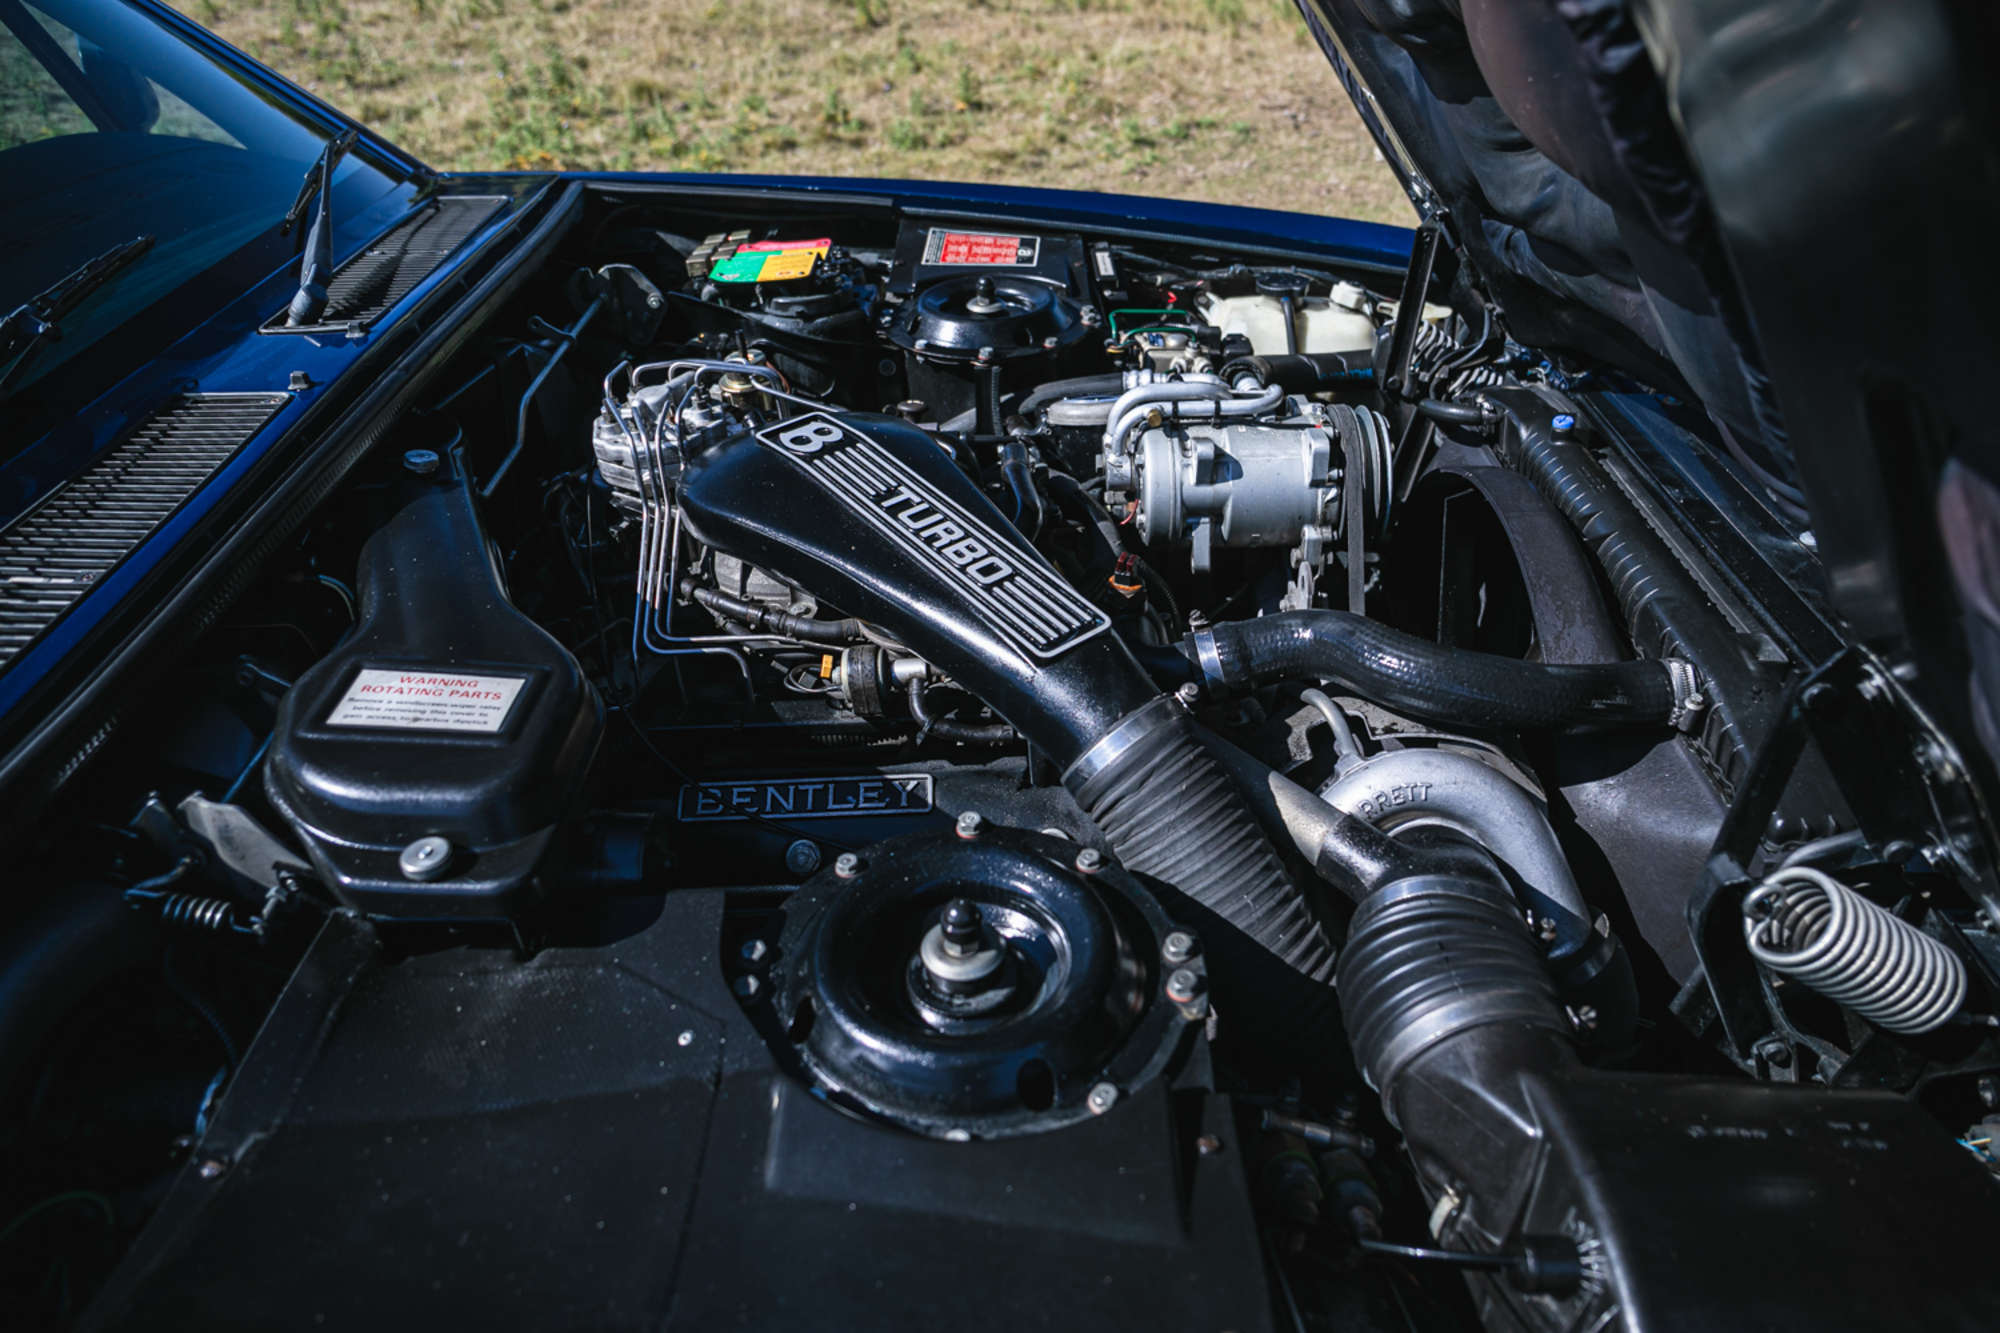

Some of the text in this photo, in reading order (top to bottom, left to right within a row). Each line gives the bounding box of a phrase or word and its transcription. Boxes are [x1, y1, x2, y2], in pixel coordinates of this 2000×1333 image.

[779, 421, 1013, 586] B TURBO
[360, 684, 502, 701] ROTATING PARTS
[399, 675, 479, 689] WARNING
[695, 780, 920, 815] BENTLEY
